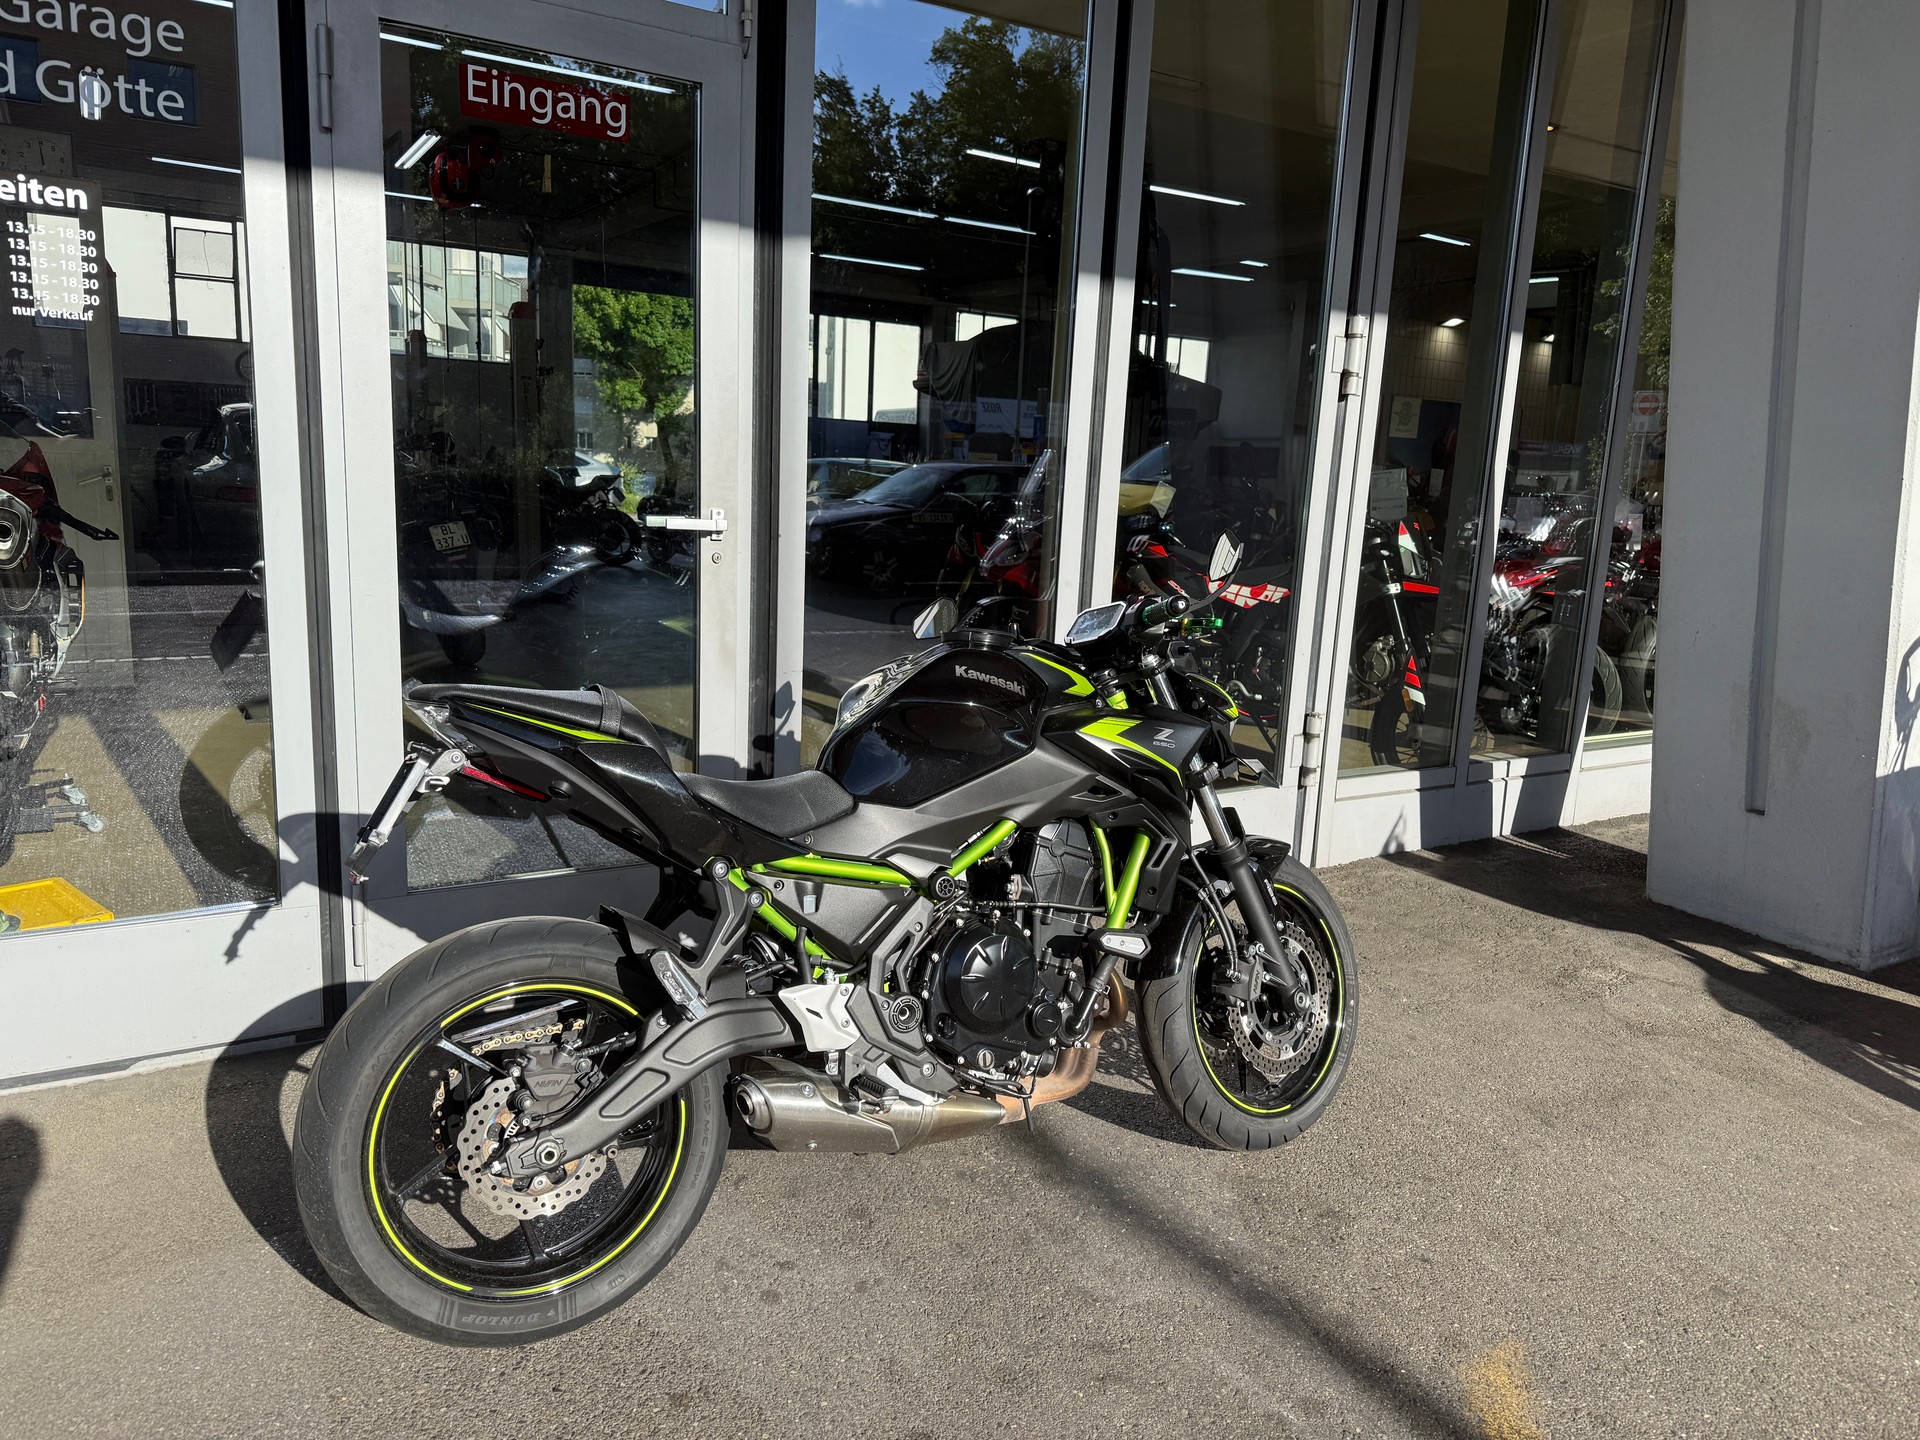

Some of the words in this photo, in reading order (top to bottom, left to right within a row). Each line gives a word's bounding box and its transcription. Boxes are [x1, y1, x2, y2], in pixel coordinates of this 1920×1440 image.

[36, 60, 184, 121] Götte
[466, 64, 628, 138] Eingang
[6, 221, 45, 235] 13.15
[57, 227, 96, 241] 18.30
[8, 238, 47, 252] 13.15
[58, 244, 97, 257] 18.30
[9, 255, 48, 268] 13.15
[60, 260, 98, 273] 18.30
[10, 271, 49, 284] 13.15
[61, 276, 99, 290] 18.30
[11, 287, 50, 300] 13.15
[62, 293, 100, 306] 18.30
[12, 306, 37, 316] nur
[39, 306, 94, 321] Verkauf
[440, 524, 456, 536] BL
[955, 665, 1026, 697] Kawasaki
[1154, 726, 1176, 743] Z
[461, 1312, 541, 1326] DUNLOP
